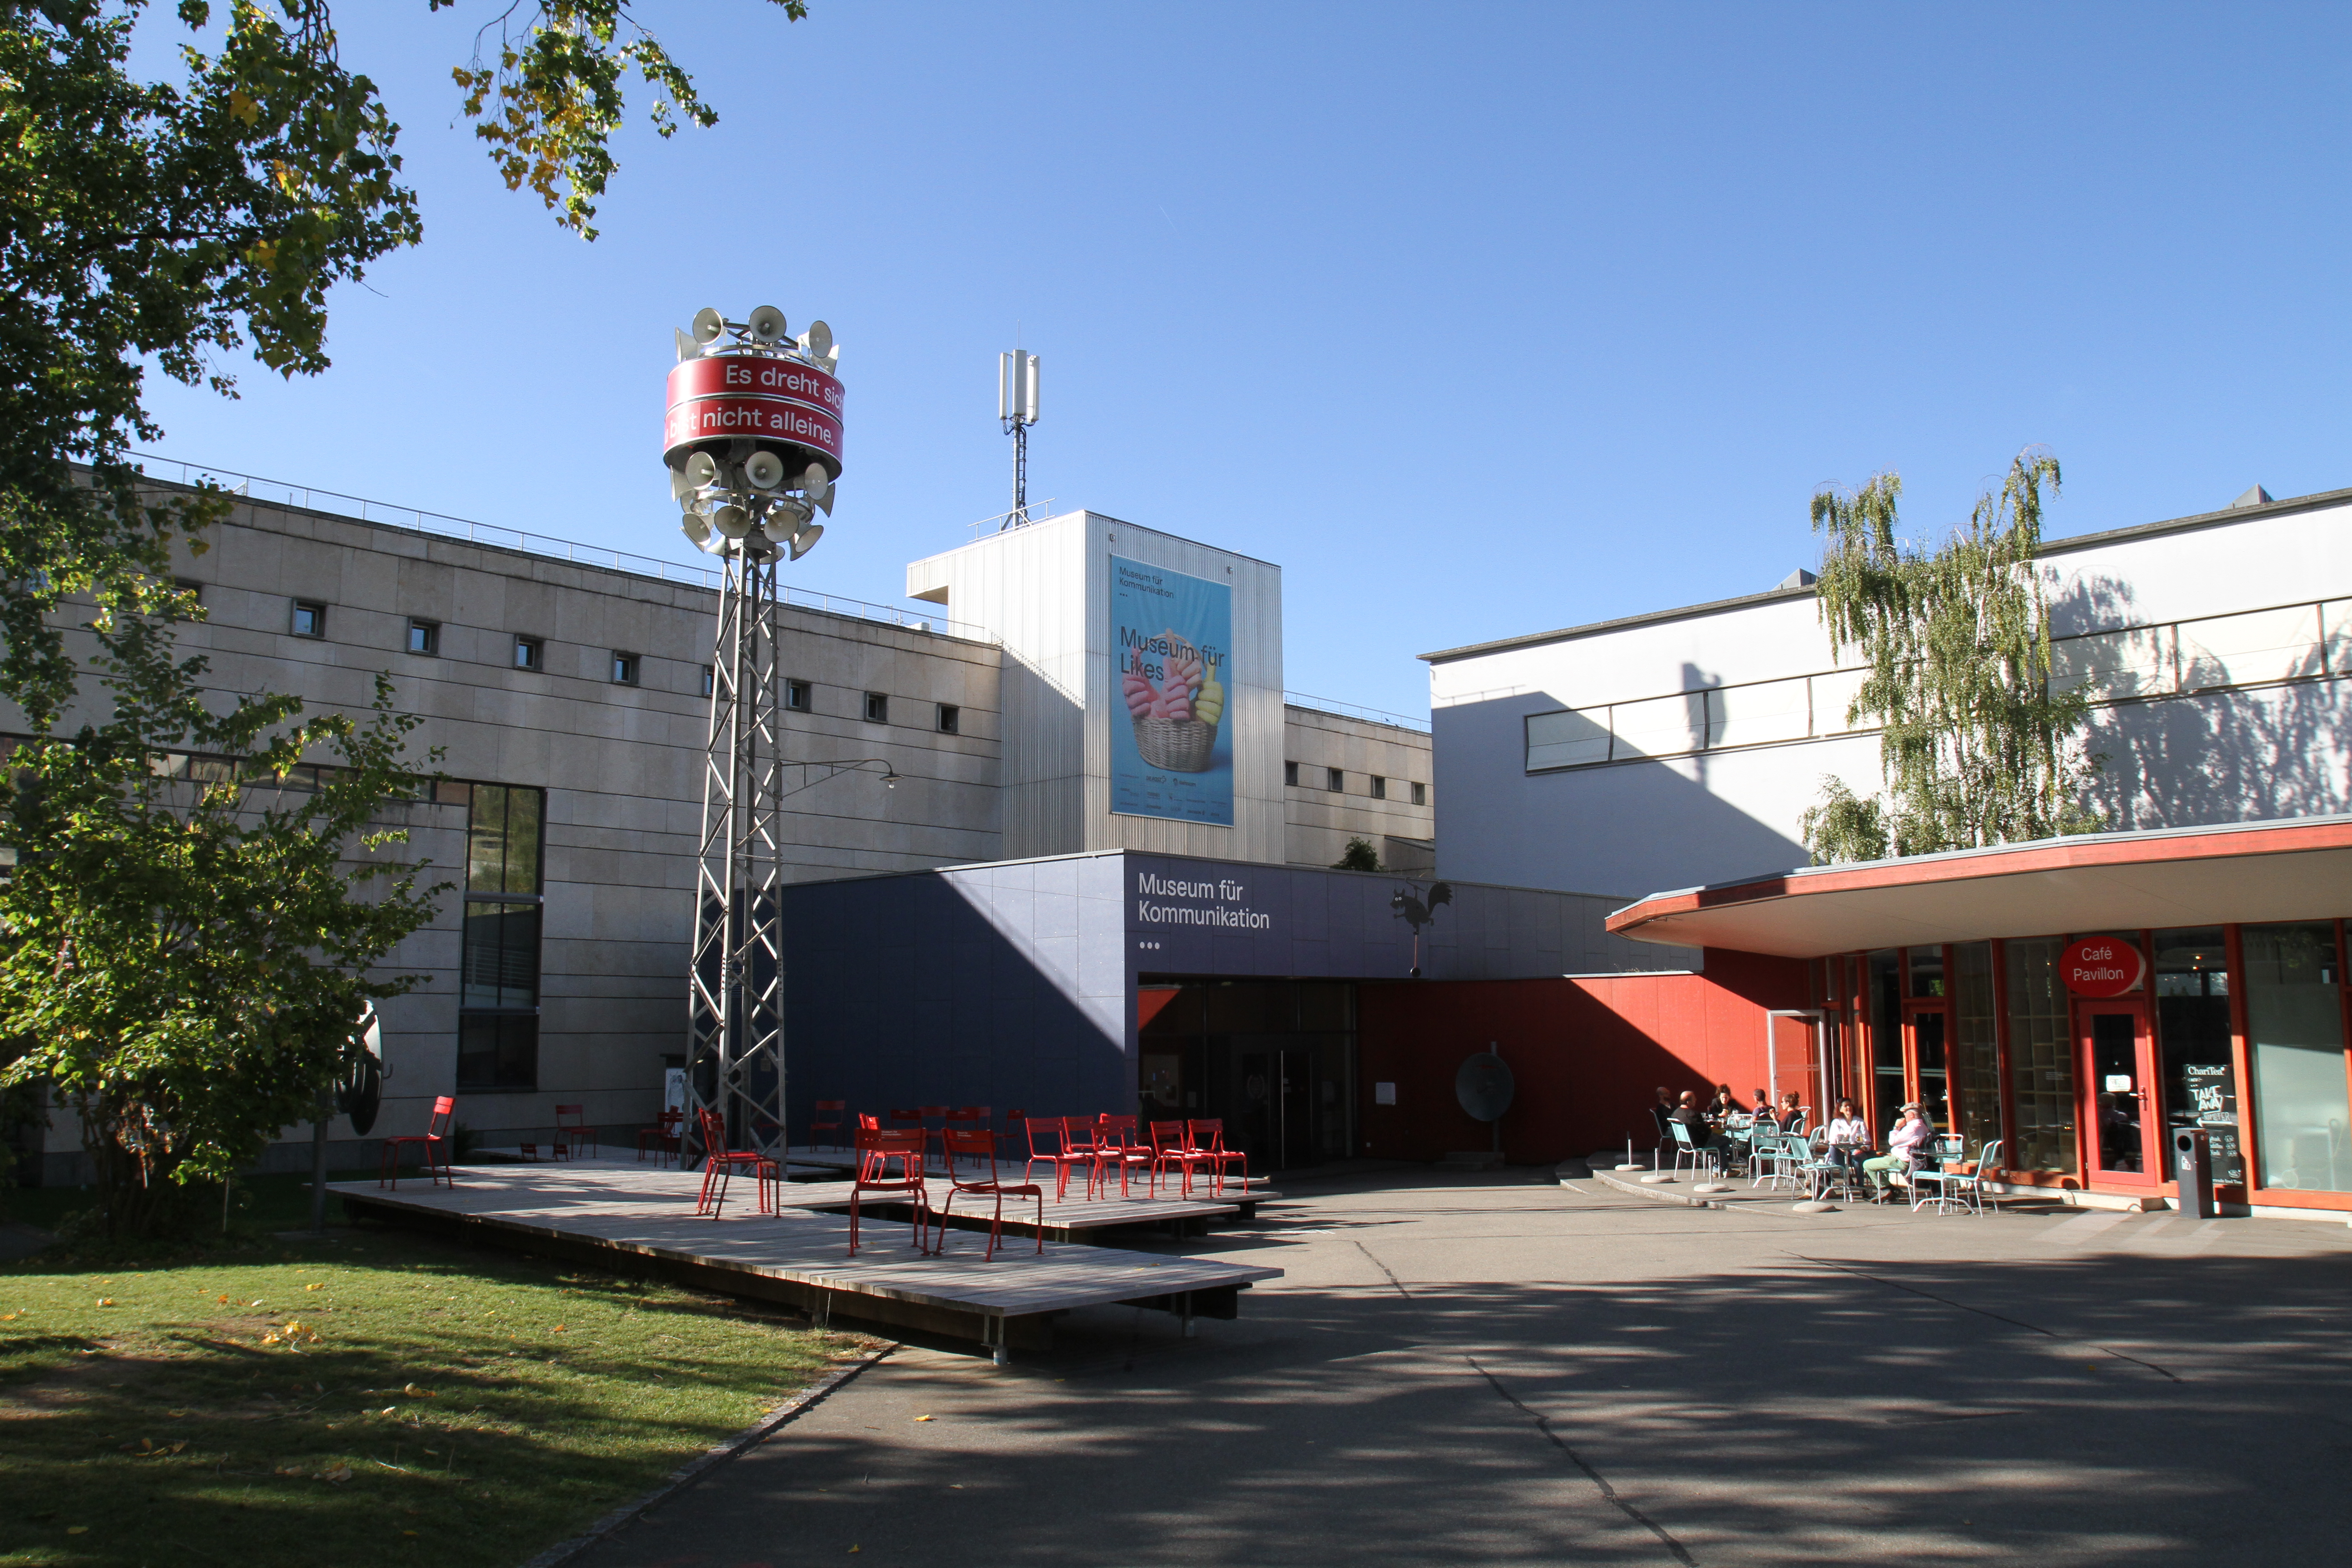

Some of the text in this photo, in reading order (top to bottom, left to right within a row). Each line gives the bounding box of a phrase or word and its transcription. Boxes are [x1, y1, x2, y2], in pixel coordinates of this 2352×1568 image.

[726, 365, 752, 384] Es
[761, 368, 819, 397] dreht
[670, 412, 697, 439] bist
[703, 407, 762, 428] nicht
[770, 412, 834, 446] alleine.
[1119, 566, 1163, 585] Museum für
[1119, 577, 1174, 598] Kommunikation
[1121, 626, 1225, 667] Museum für
[1121, 653, 1164, 681] Likes
[1138, 872, 1243, 901] Museum für
[1138, 900, 1270, 929] Kommunikation
[2082, 946, 2112, 961] Café
[2073, 967, 2124, 981] Pavillon
[2189, 1085, 2222, 1101] TAKE
[2198, 1097, 2224, 1112] AWAY
